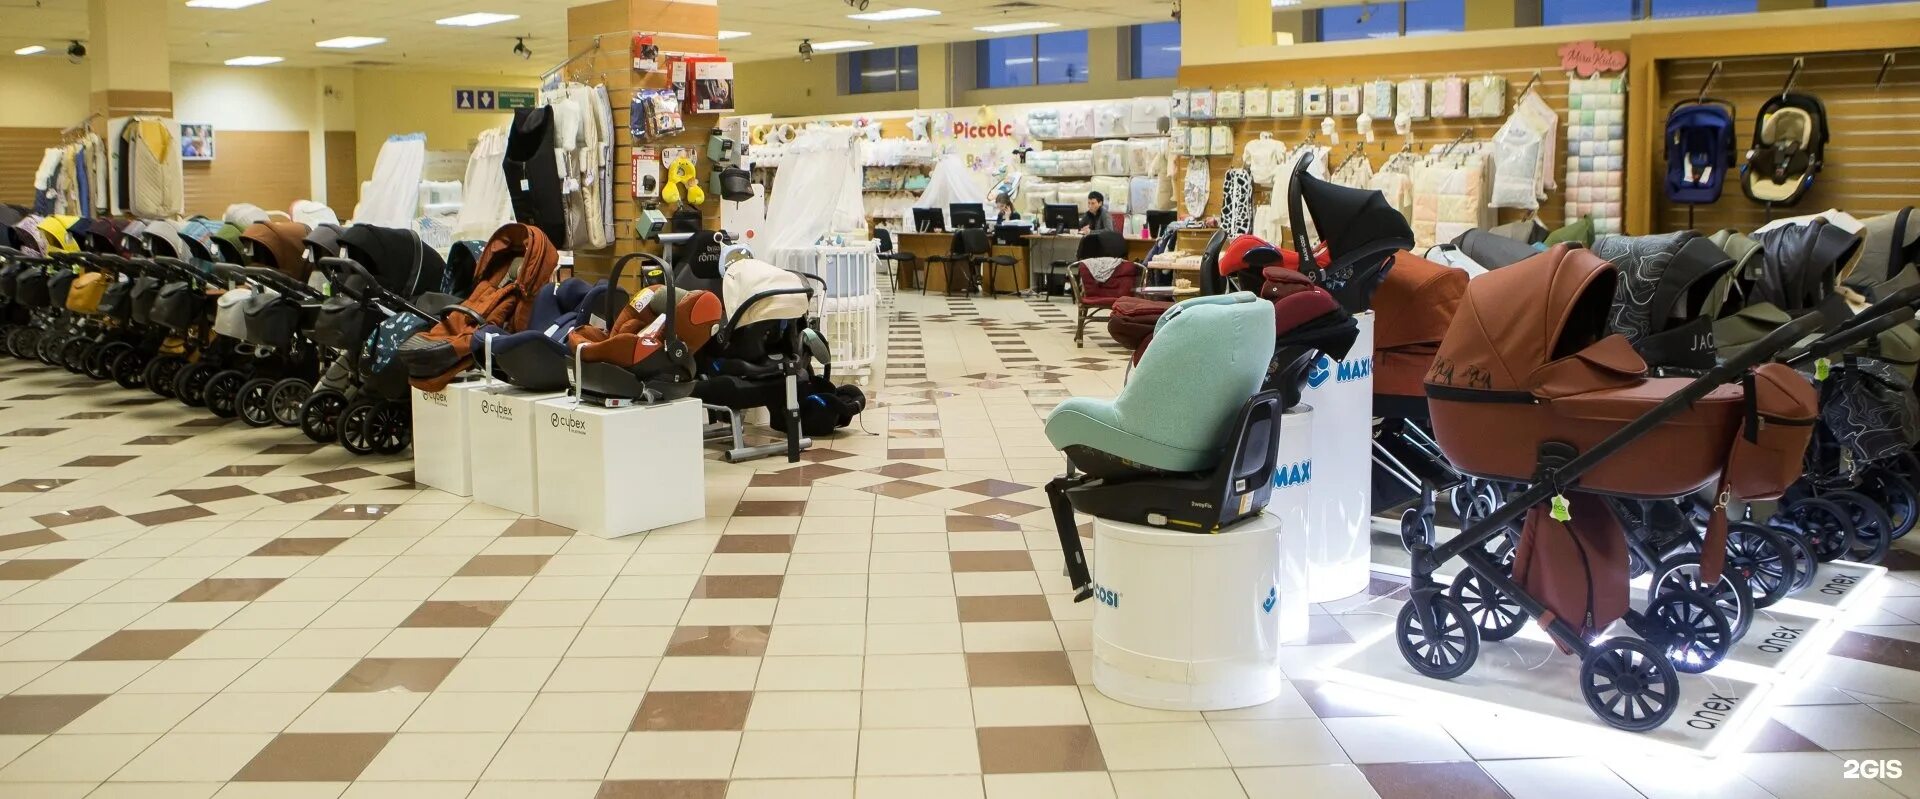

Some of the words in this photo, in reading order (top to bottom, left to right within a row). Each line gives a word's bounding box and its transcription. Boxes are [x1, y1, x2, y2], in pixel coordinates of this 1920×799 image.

[1691, 332, 1714, 351] JAC
[490, 401, 513, 417] cybex
[560, 414, 586, 432] cybex
[1819, 573, 1861, 596] anex
[1757, 625, 1804, 654] anex
[1686, 692, 1740, 730] anex
